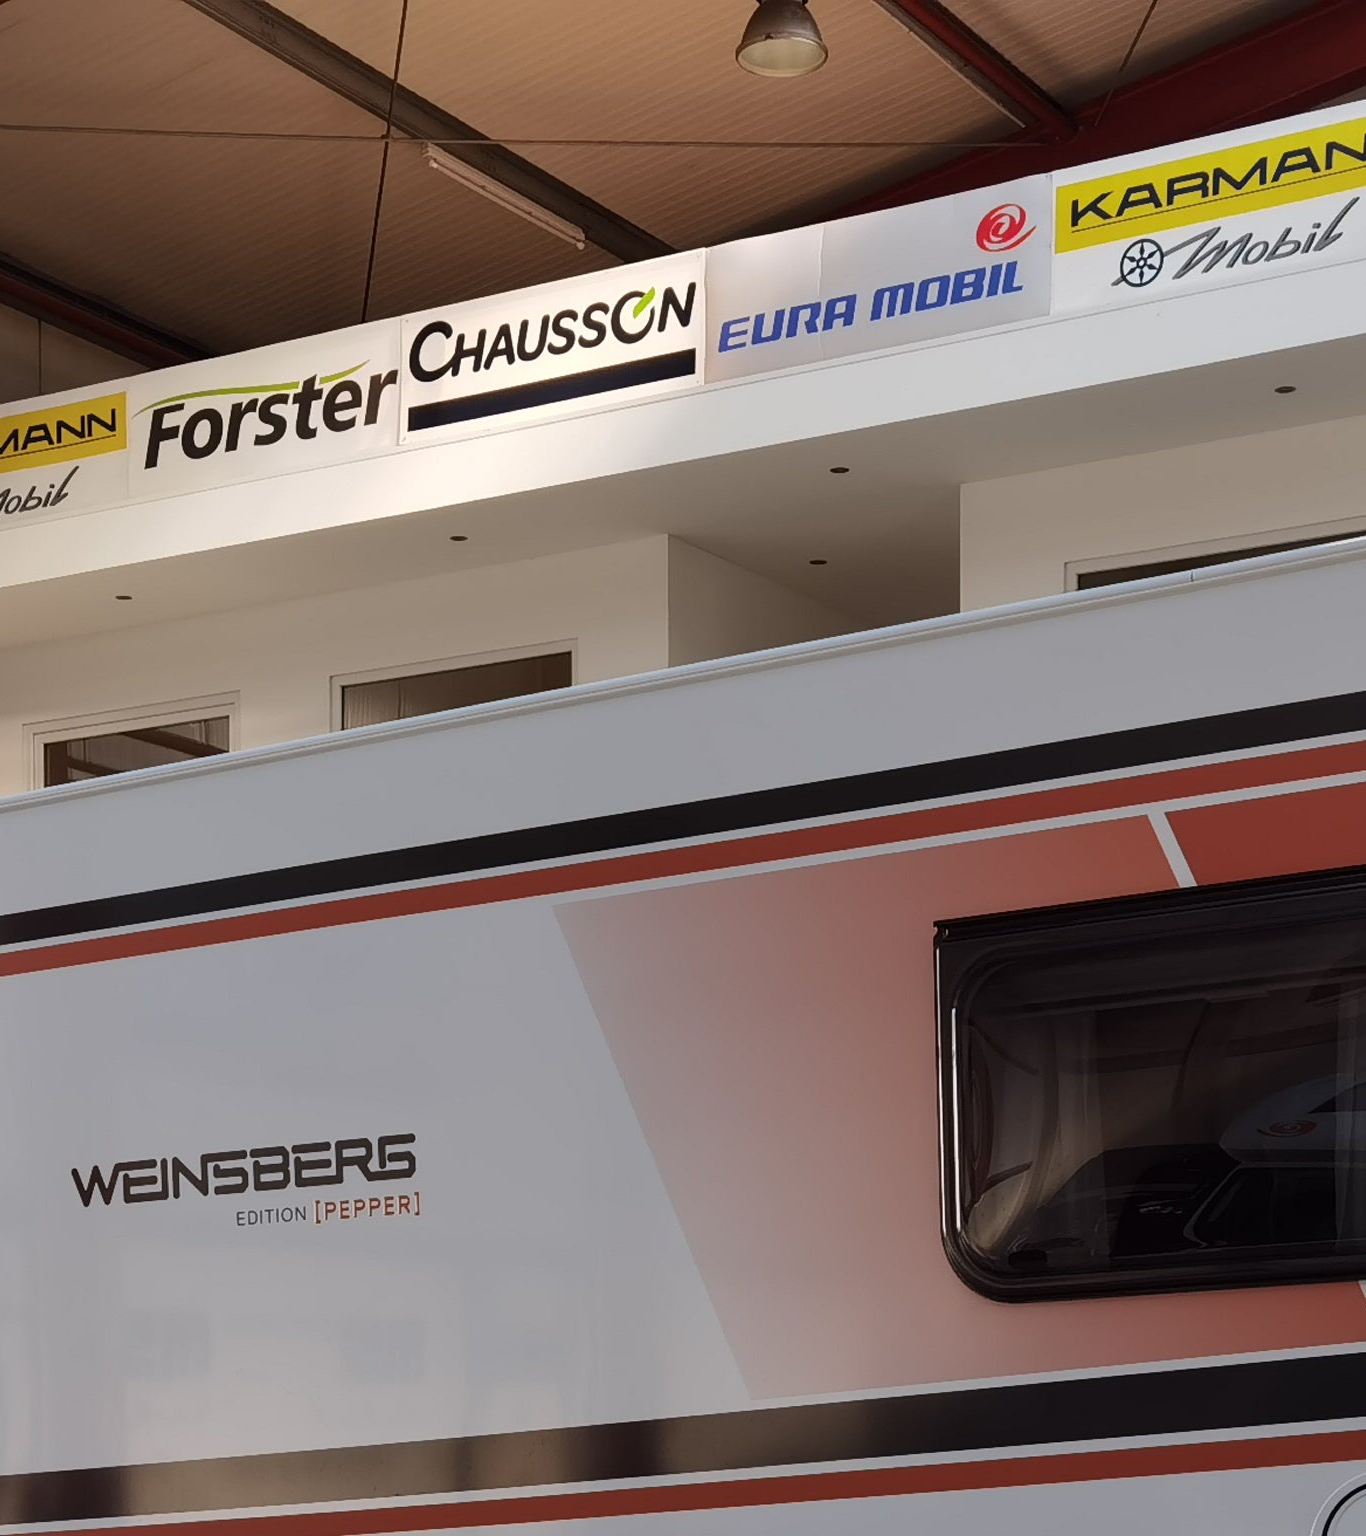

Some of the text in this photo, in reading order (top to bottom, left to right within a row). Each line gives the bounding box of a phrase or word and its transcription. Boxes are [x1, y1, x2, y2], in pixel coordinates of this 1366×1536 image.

[1164, 196, 1361, 280] Mobil
[408, 281, 697, 383] CHAUSSON
[717, 259, 1025, 353] EURA MOBIL
[143, 366, 398, 470] Forster
[71, 1133, 416, 1208] WEINSBERG
[236, 1191, 422, 1226] EDITION [PEPPER]
